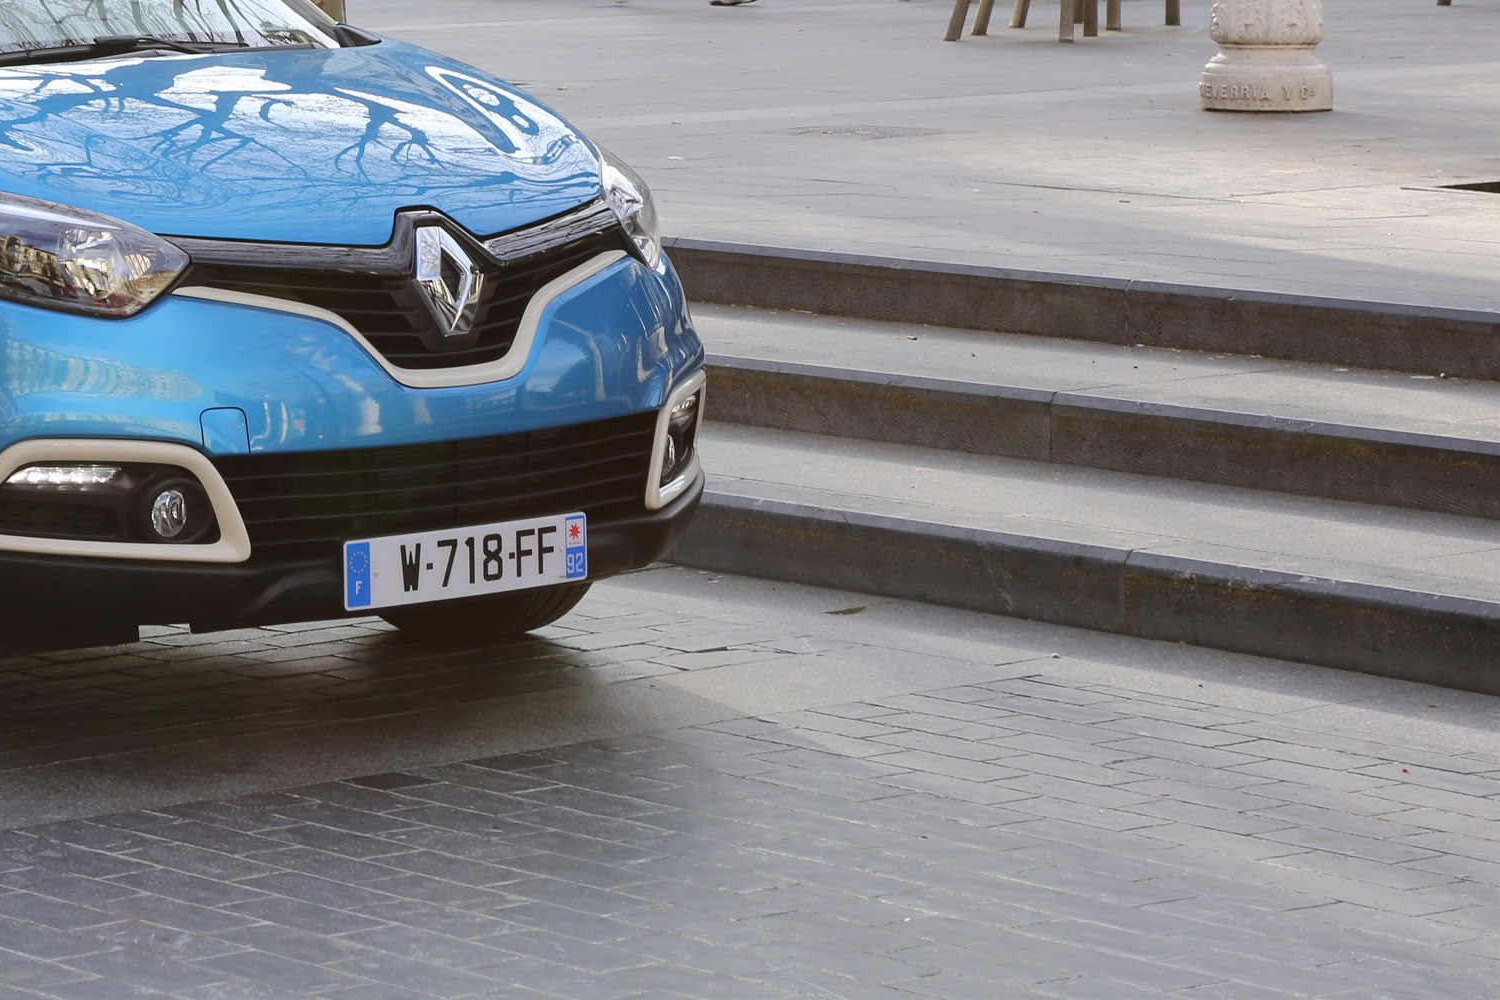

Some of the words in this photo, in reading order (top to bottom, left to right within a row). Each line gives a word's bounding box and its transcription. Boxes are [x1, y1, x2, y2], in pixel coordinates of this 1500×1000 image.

[1282, 84, 1294, 102] Y
[399, 525, 558, 593] W-718-FF
[566, 552, 584, 575] 92
[355, 580, 363, 595] F
